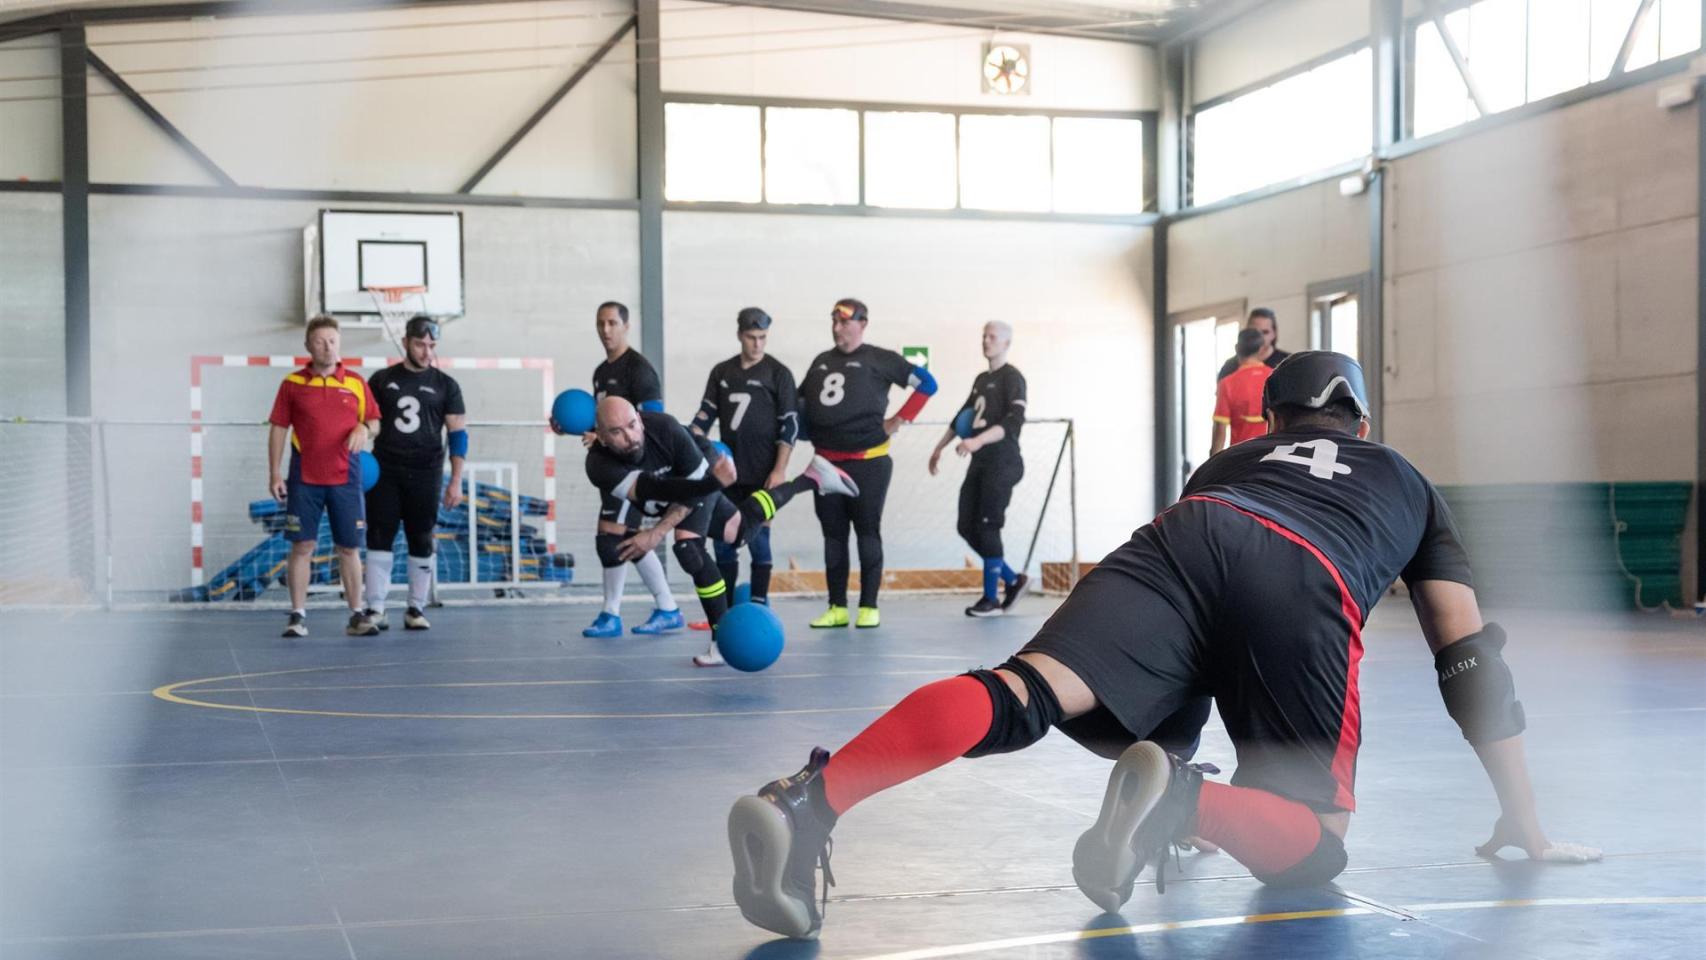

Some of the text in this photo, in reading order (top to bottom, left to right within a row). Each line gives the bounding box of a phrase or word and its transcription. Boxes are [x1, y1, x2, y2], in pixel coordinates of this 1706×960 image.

[819, 372, 846, 407] 8
[394, 395, 421, 434] 3
[728, 393, 752, 431] 7
[972, 395, 987, 429] 2
[1259, 438, 1352, 480] 4
[1441, 656, 1478, 682] ALLSIX
